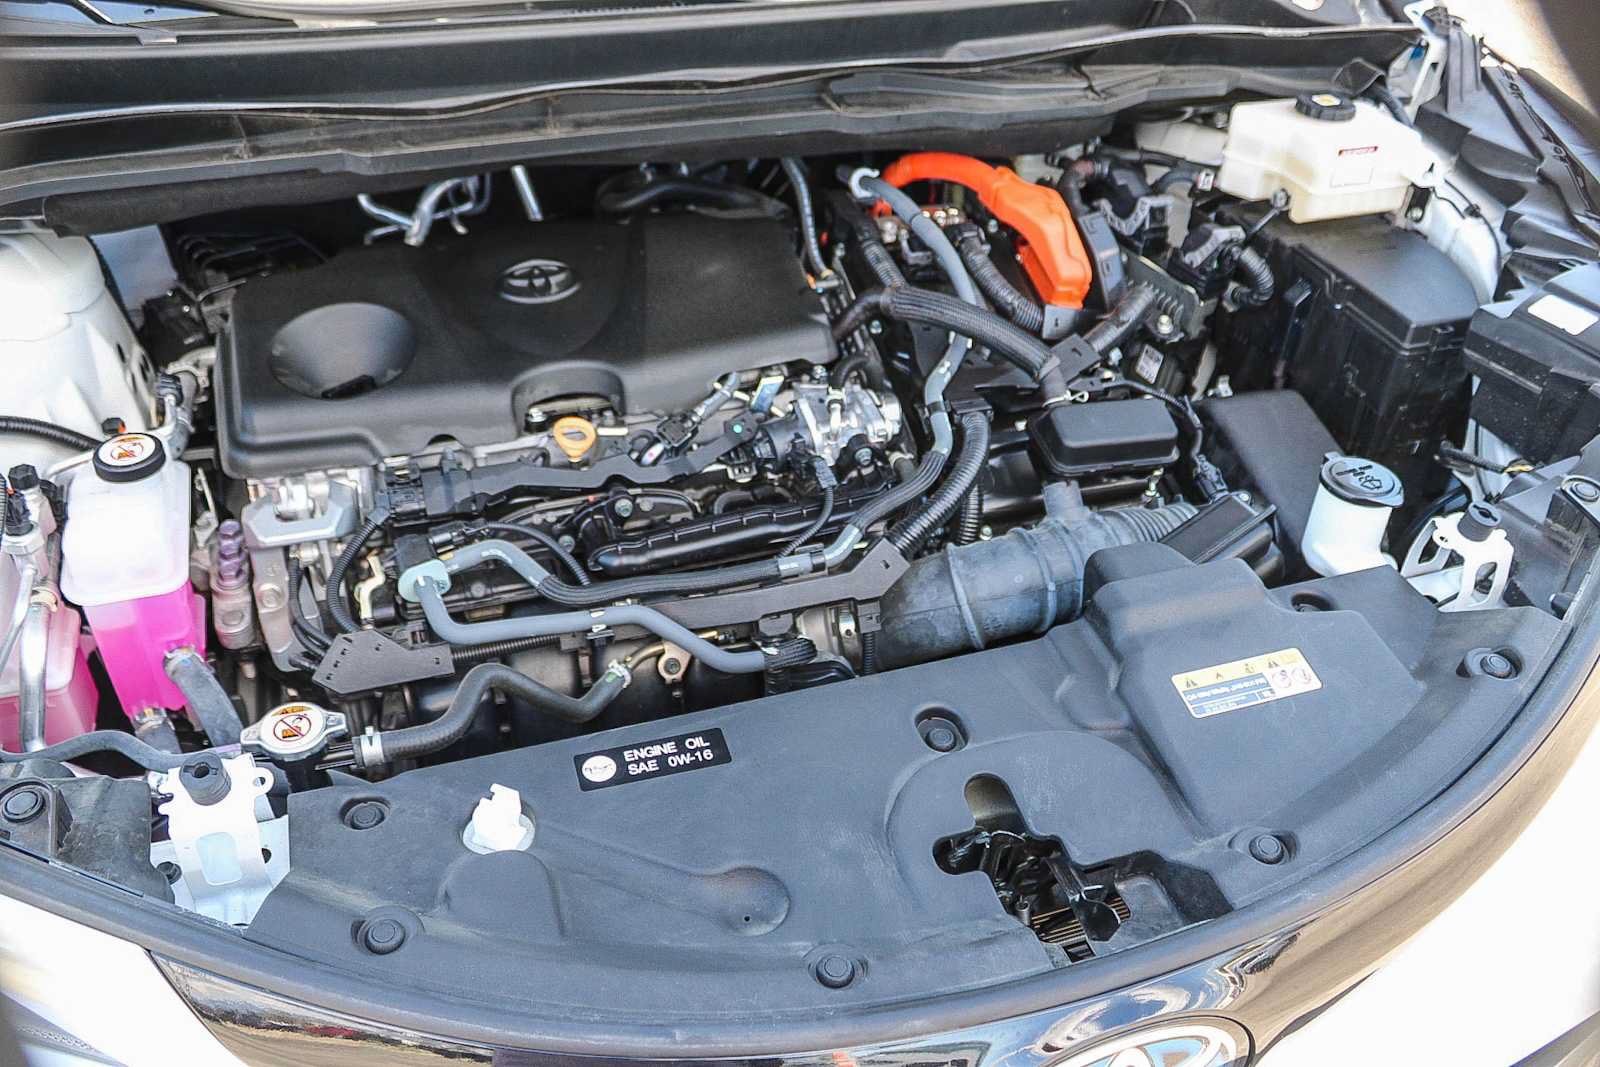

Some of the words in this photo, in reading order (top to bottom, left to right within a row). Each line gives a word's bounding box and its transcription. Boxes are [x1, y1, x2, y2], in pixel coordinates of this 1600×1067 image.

[623, 741, 678, 762] ENGINE
[685, 736, 711, 750] OIL
[628, 759, 660, 776] SAE
[667, 749, 714, 768] 0W-16
